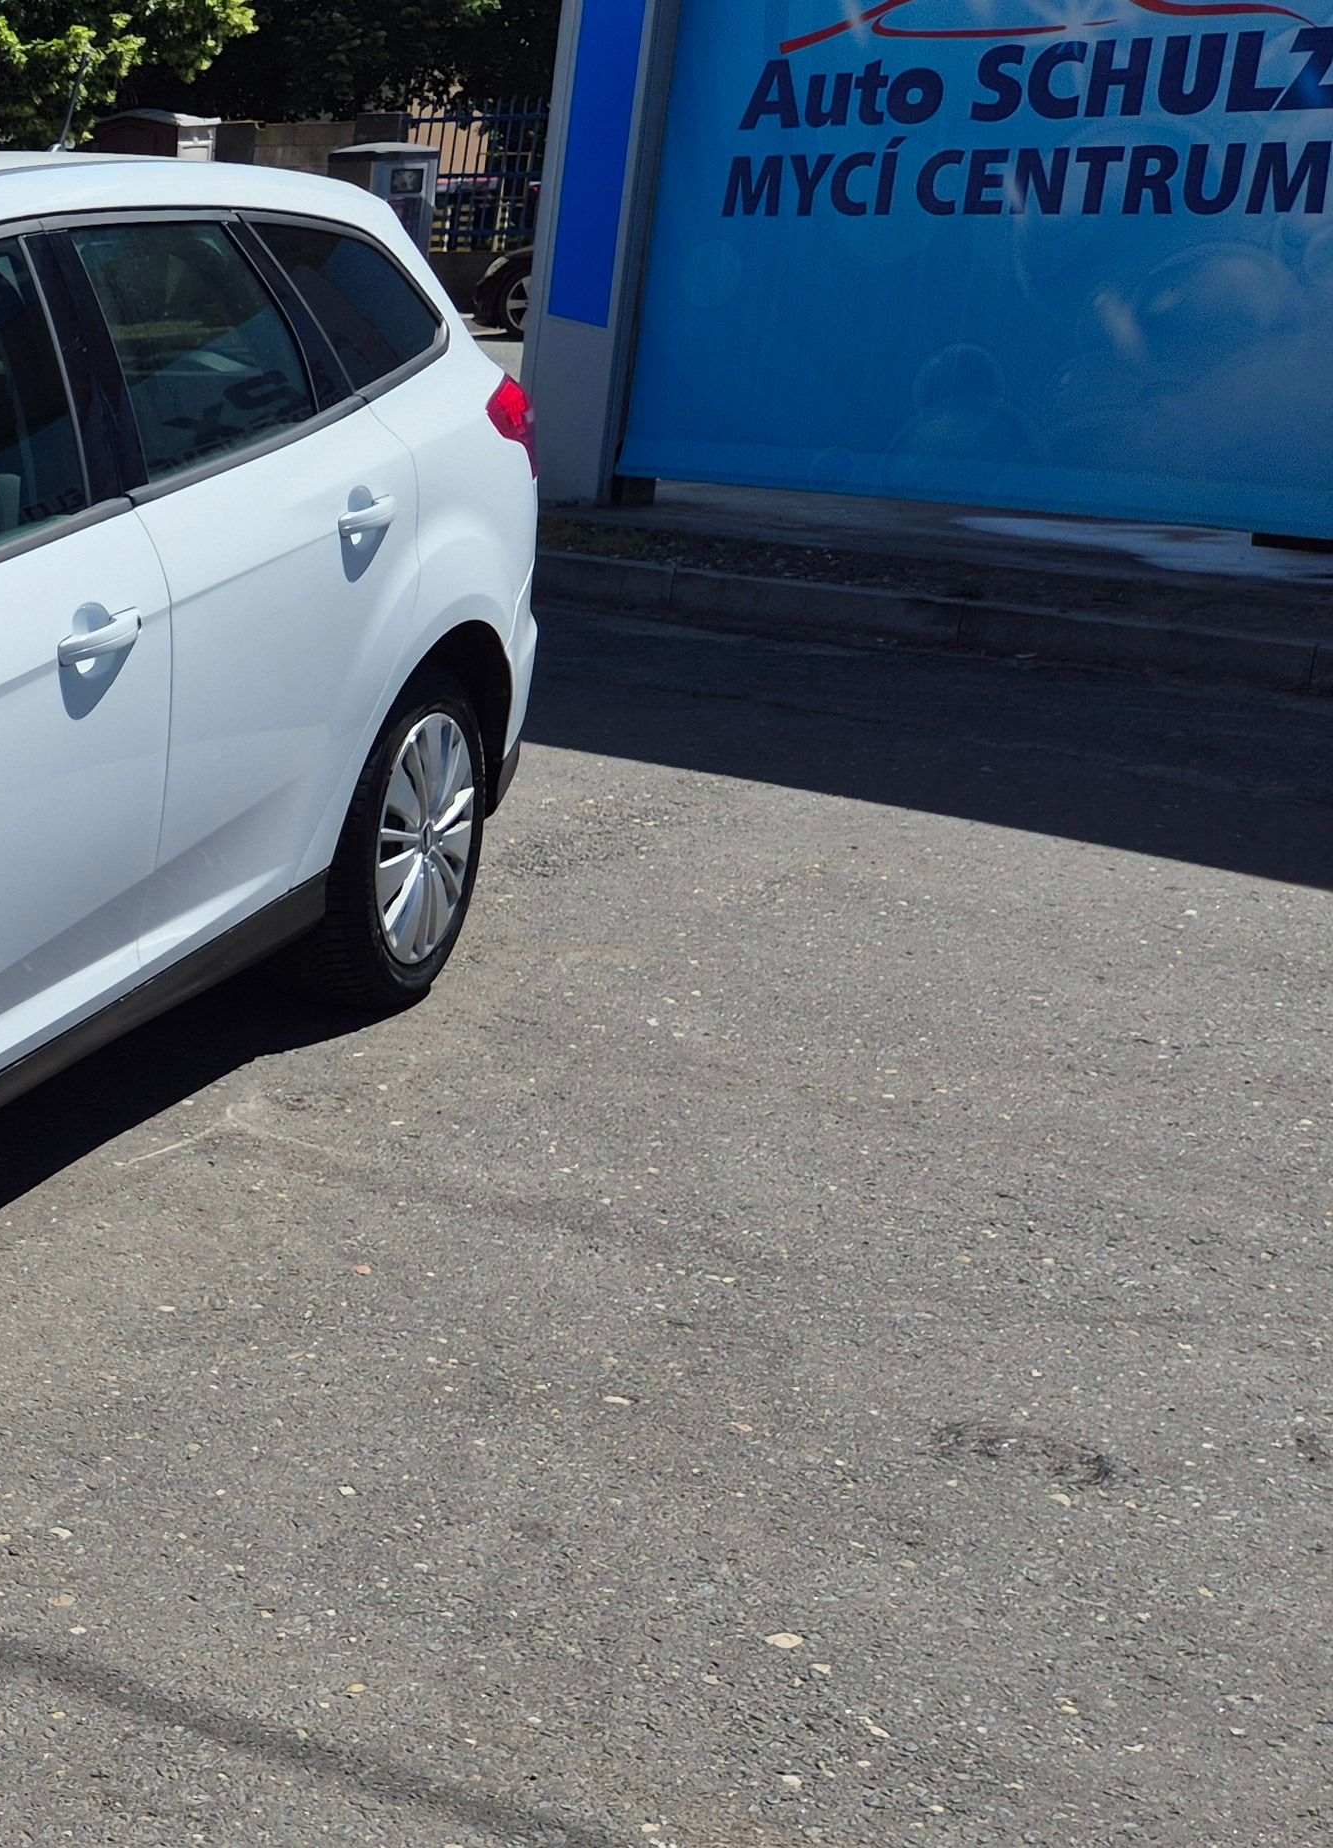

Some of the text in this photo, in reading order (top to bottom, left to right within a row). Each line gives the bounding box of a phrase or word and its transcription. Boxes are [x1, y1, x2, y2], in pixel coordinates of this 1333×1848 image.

[738, 26, 1333, 130] Auto SCHULZ
[721, 136, 1333, 217] MYCÍ CENTRUM
